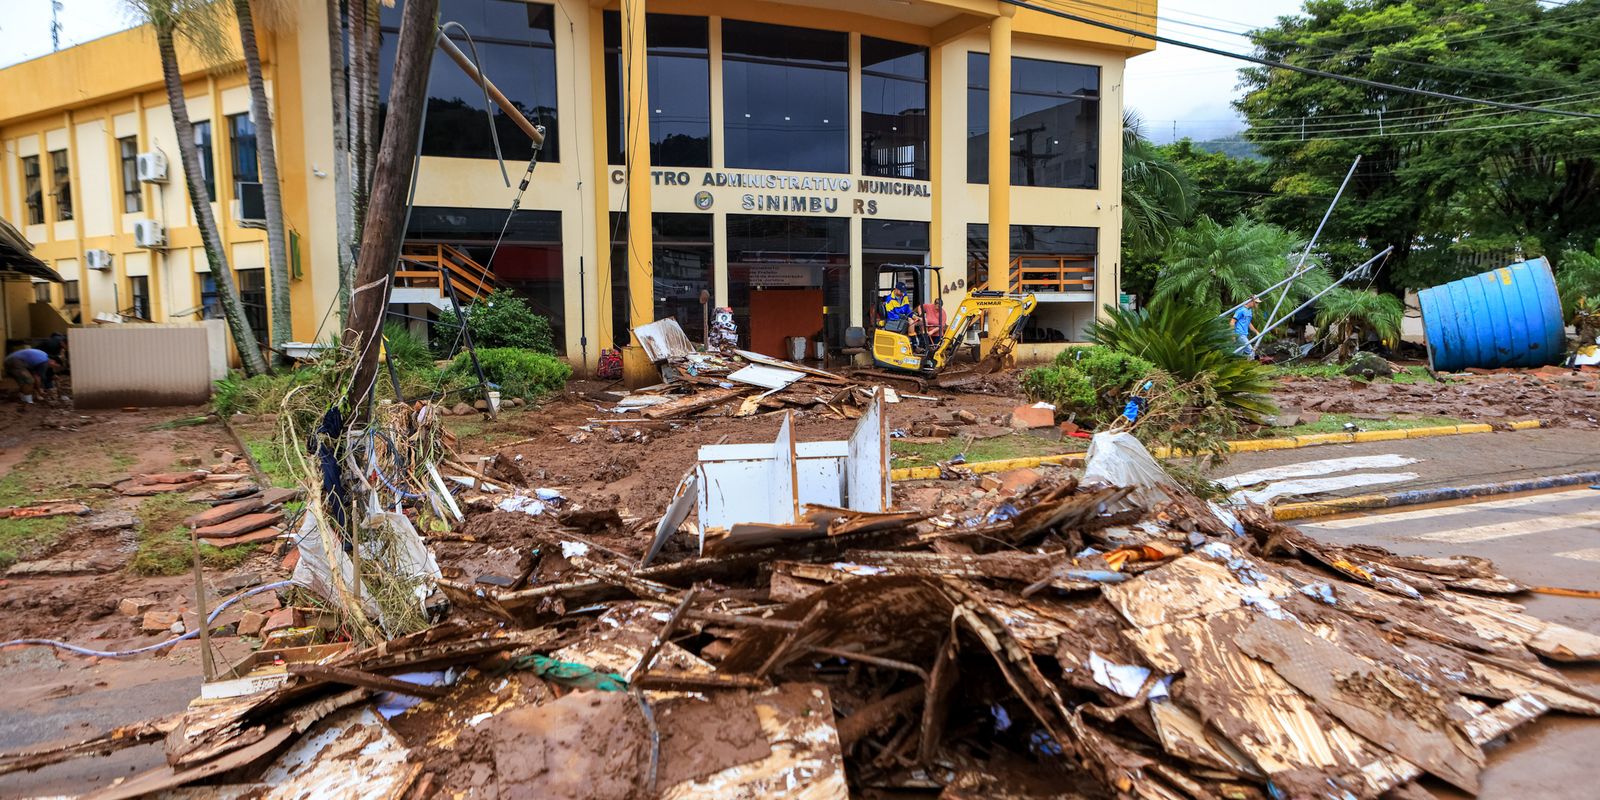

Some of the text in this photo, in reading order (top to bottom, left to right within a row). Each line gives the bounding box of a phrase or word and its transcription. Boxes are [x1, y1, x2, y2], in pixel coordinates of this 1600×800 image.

[611, 169, 931, 198] CTRO ADMINISTRATIVO MUNICIPAL
[742, 194, 878, 215] SINIMBU RS
[942, 278, 965, 294] 449
